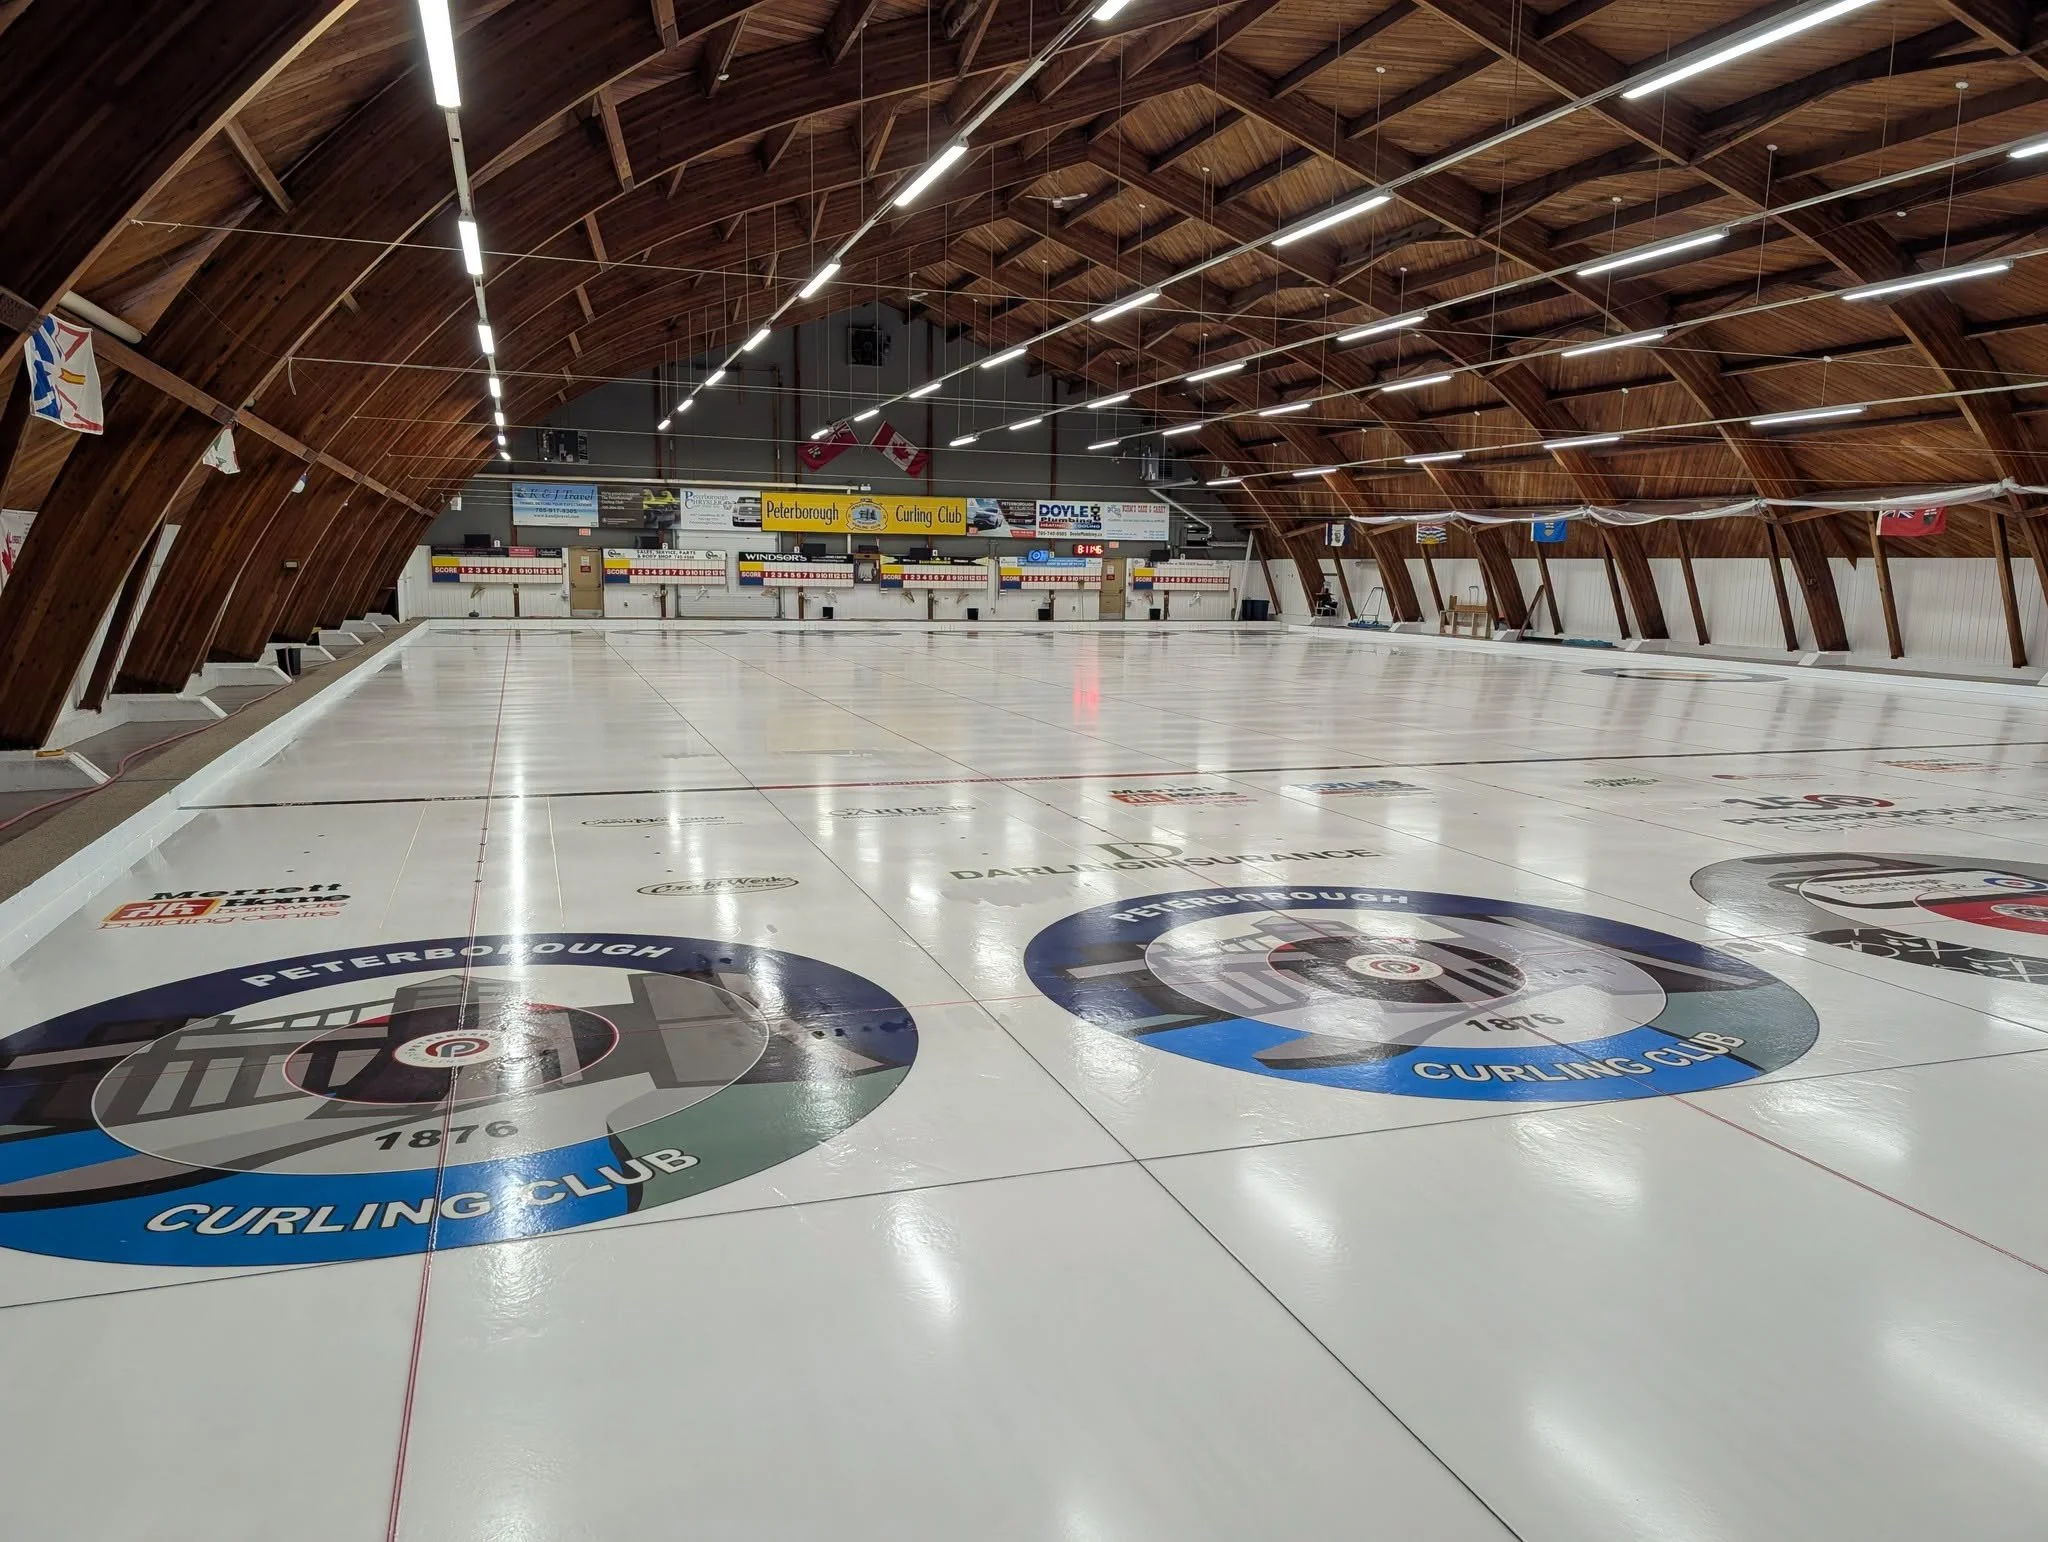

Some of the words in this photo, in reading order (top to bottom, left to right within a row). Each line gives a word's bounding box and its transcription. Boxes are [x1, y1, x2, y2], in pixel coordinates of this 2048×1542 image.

[529, 488, 538, 498] K
[563, 490, 594, 500] Travel
[684, 490, 728, 500] Peterborough
[766, 501, 839, 526] Peterborough
[896, 505, 932, 528] Curling
[938, 506, 962, 524] Club
[1039, 504, 1088, 517] DOYLE
[745, 553, 807, 561] WINDSOR'S
[830, 806, 976, 816] GARDENS
[1722, 805, 2028, 825] PETERBOROUGH
[1784, 818, 1954, 832] CURLING
[148, 883, 342, 900] Merrett
[221, 894, 351, 907] Home
[216, 902, 347, 914] hardware
[1108, 890, 1408, 924] PETERBOROUGH
[98, 915, 236, 930] building
[241, 910, 340, 922] centre
[240, 942, 674, 989] PETERBOROUGH
[1464, 1012, 1564, 1034] 1876
[1412, 1050, 1655, 1084] CURLING
[1648, 1030, 1746, 1070] CLUB
[374, 1120, 518, 1152] 1876
[144, 1190, 504, 1238] CURLING
[506, 1146, 702, 1208] CLUB
